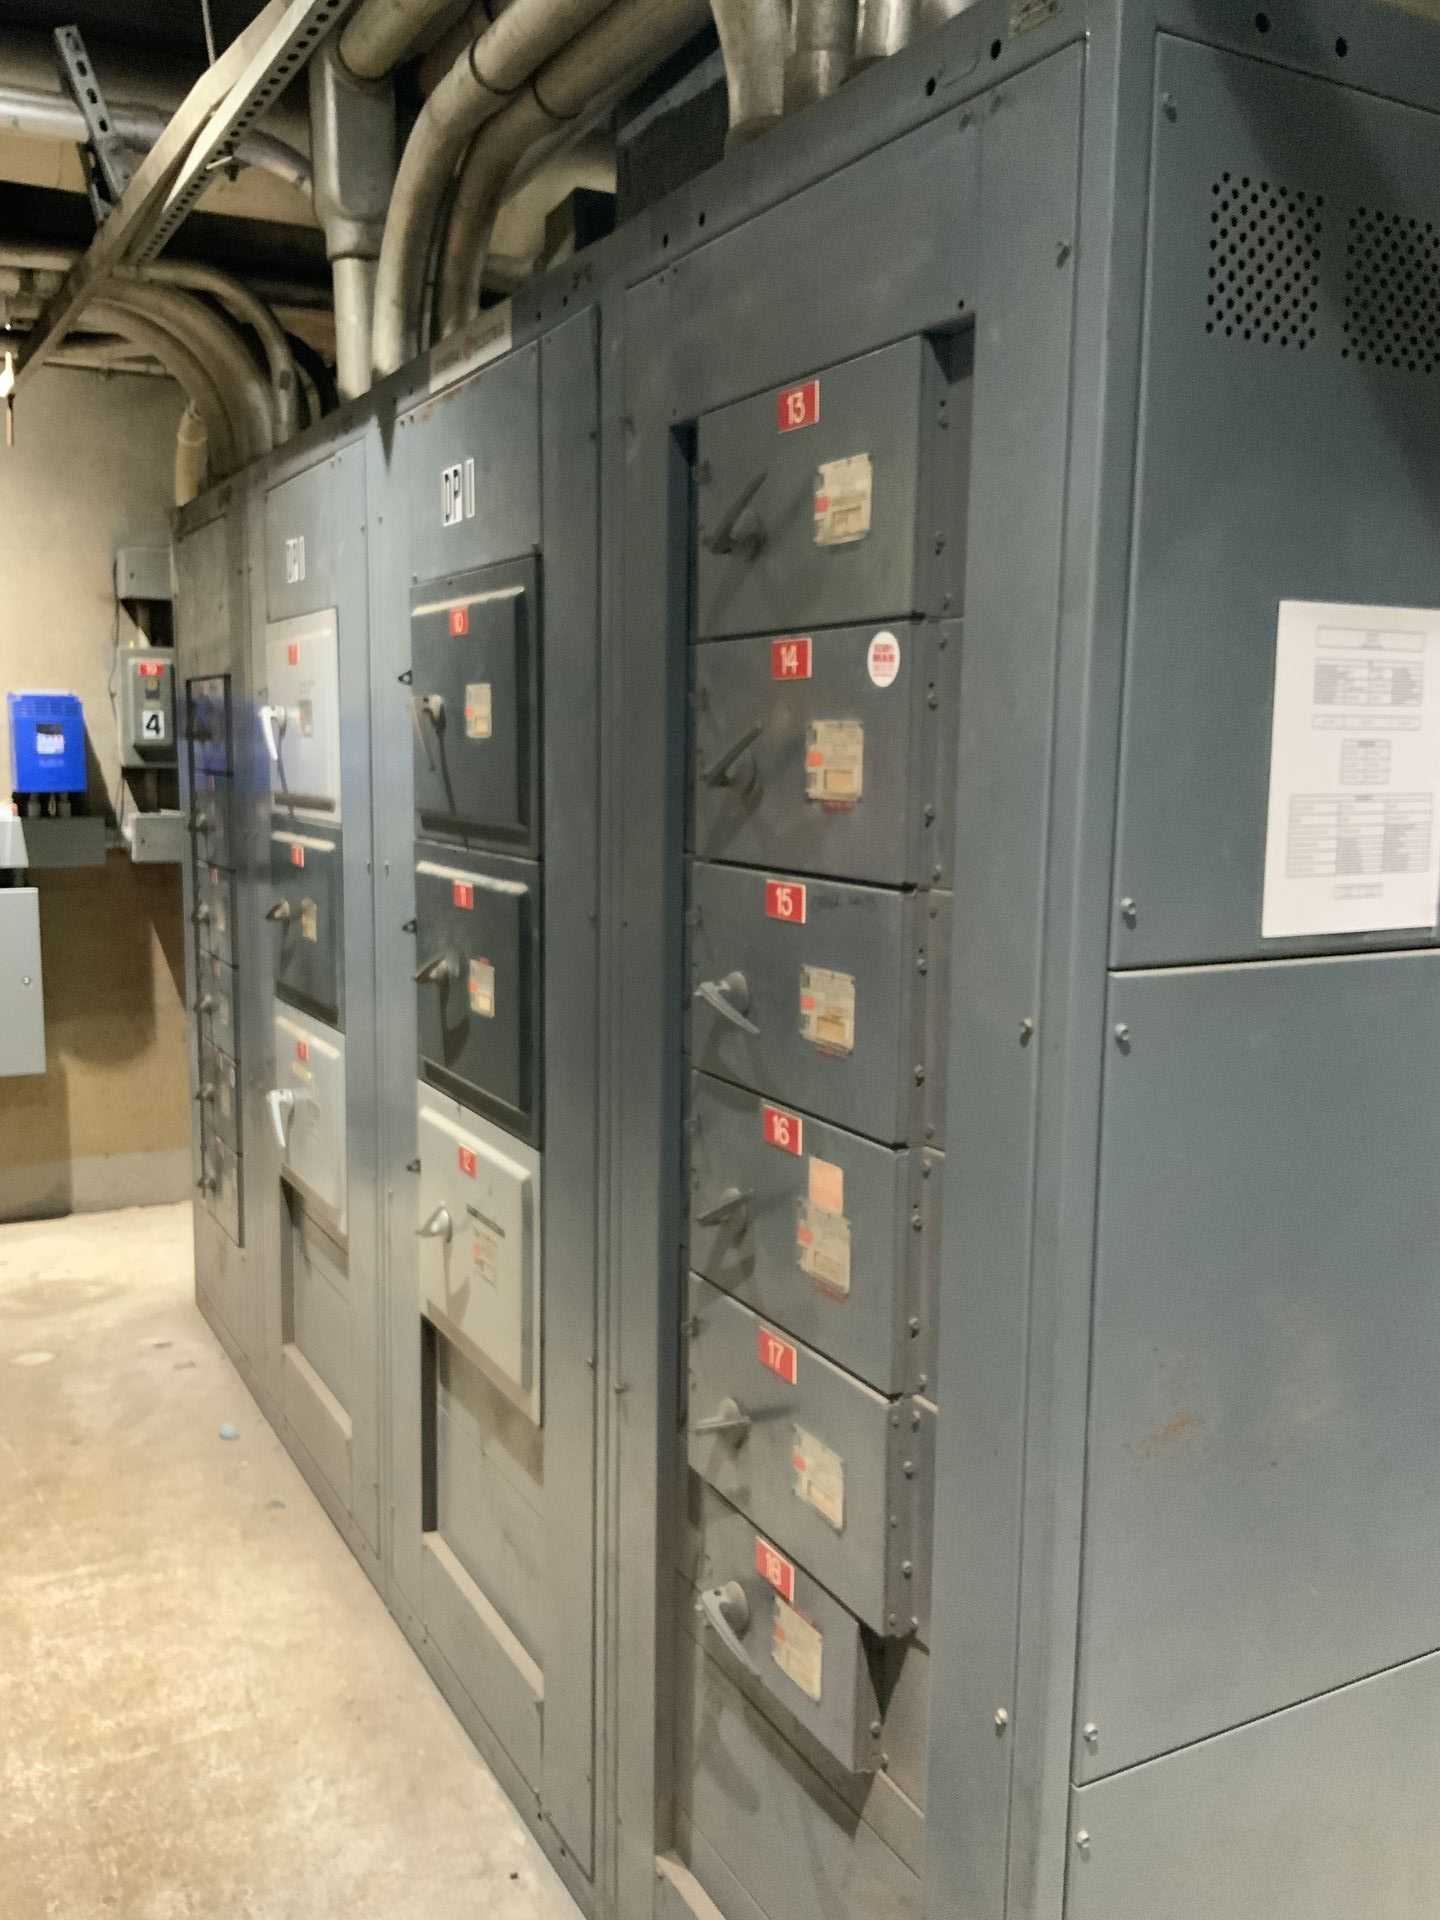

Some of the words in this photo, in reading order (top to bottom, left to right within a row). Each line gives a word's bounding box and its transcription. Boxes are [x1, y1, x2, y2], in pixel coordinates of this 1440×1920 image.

[781, 644, 799, 675] 14
[145, 713, 161, 735] 4
[775, 887, 793, 917] 15
[772, 1114, 790, 1146] 16
[768, 1338, 784, 1370] 17
